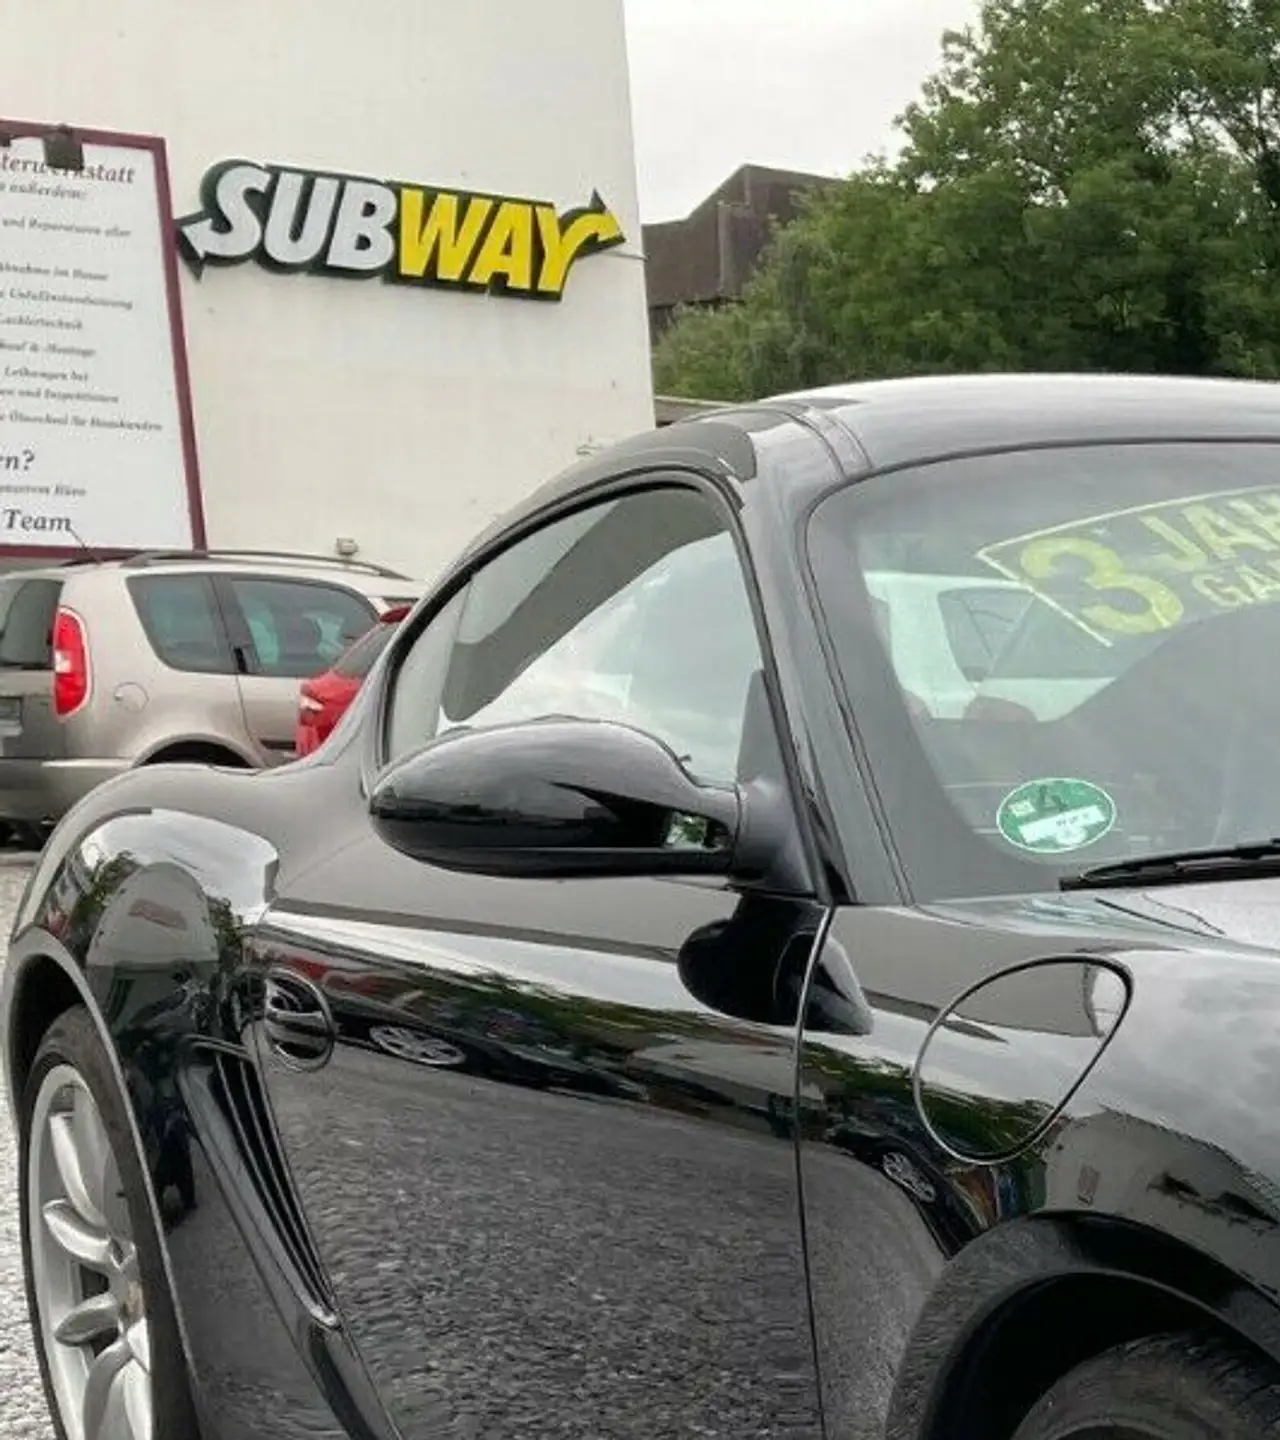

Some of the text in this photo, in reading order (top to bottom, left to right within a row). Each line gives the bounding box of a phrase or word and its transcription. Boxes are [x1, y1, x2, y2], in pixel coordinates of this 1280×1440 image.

[2, 216, 25, 230] und
[178, 160, 626, 298] SUBWAY
[4, 508, 72, 532] Team
[1019, 535, 1184, 635] 3
